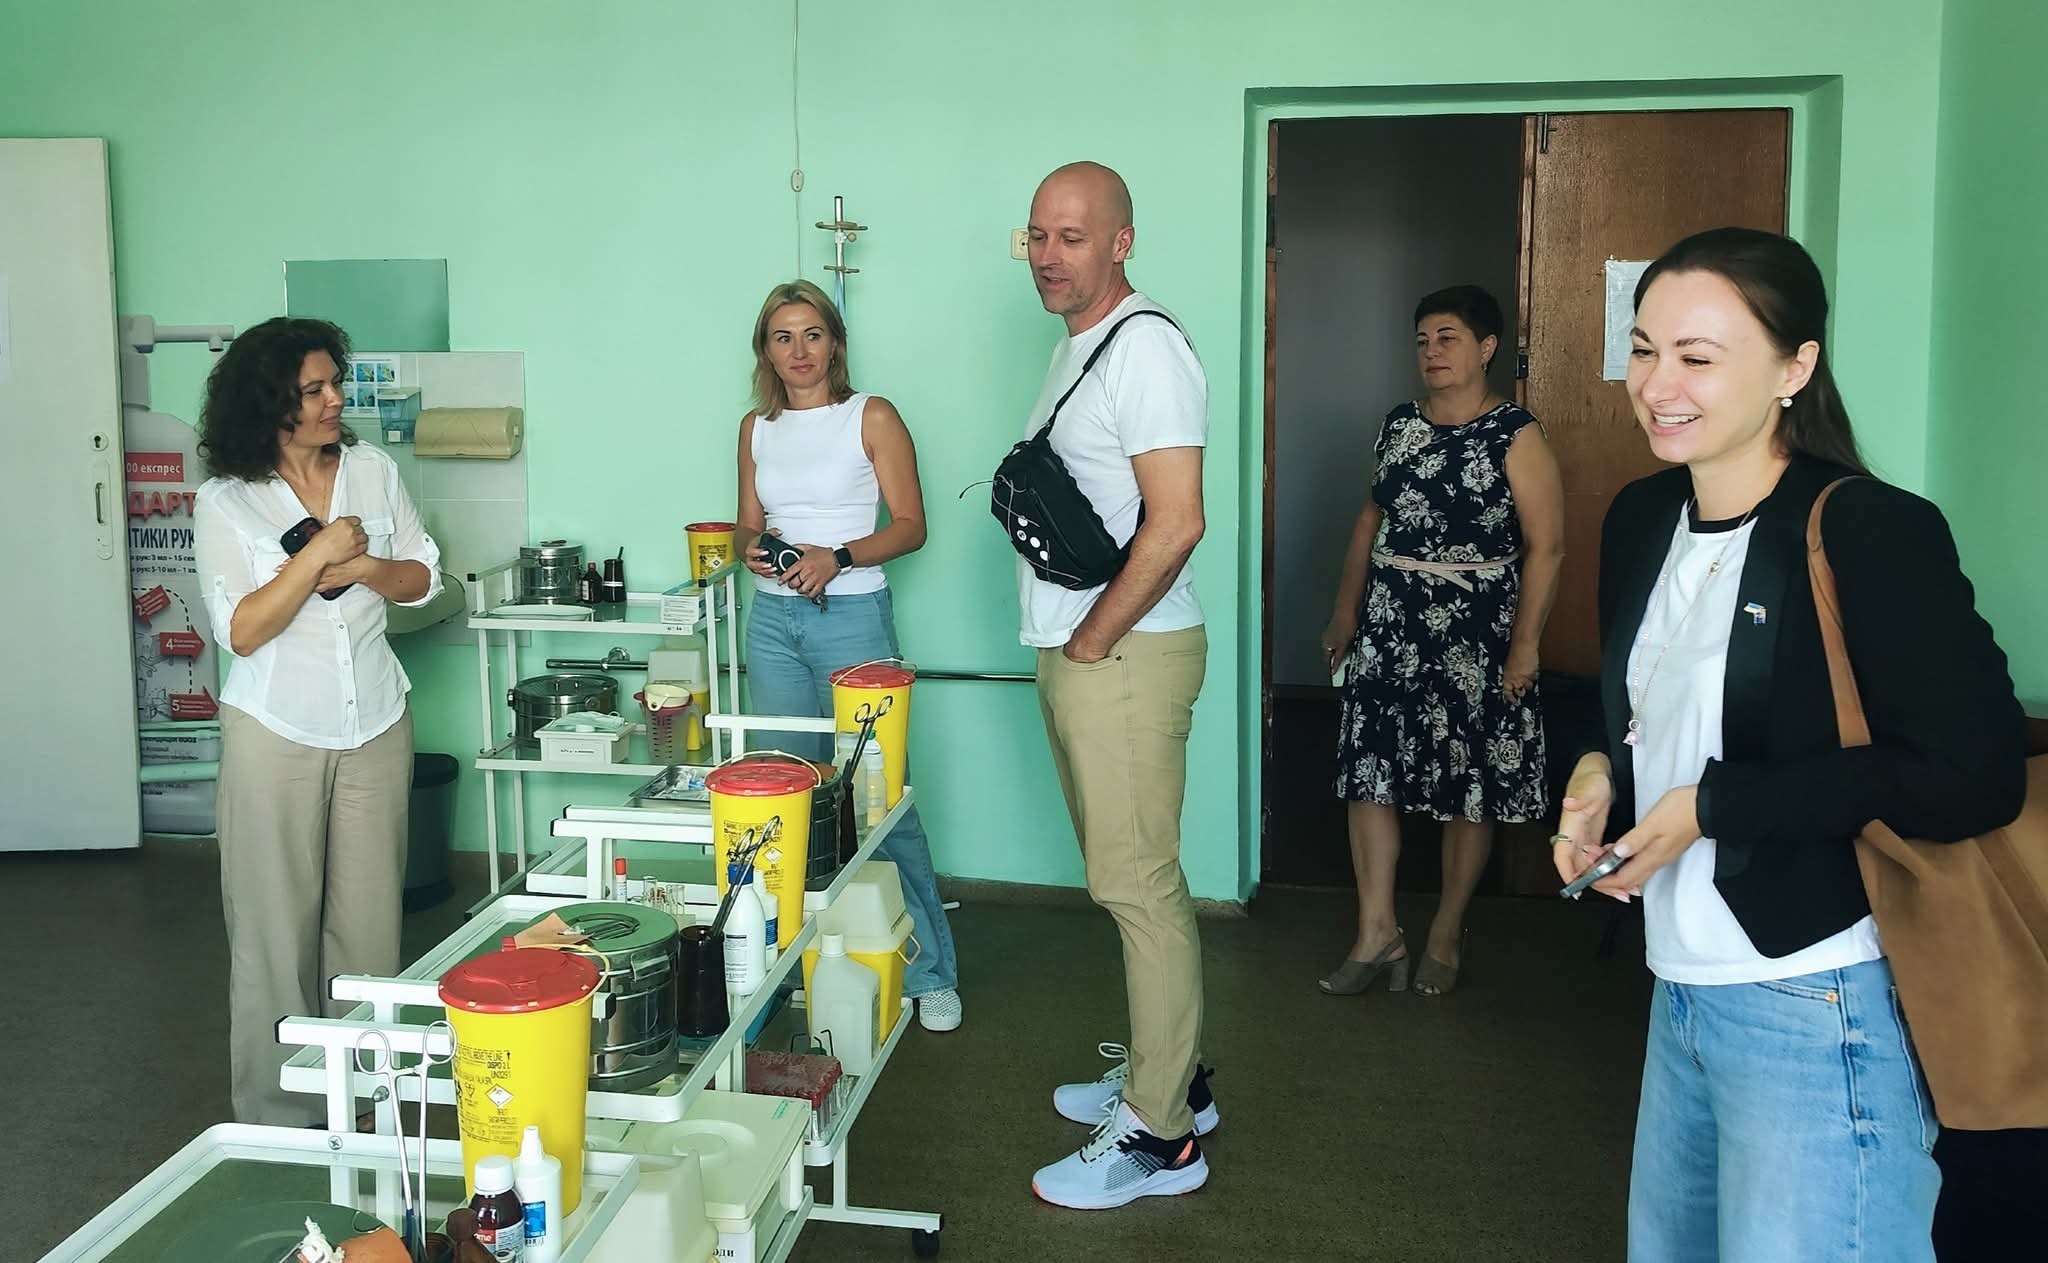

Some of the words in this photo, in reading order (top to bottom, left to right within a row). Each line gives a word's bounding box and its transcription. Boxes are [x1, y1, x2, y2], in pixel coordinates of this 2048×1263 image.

[141, 463, 181, 476] експрес
[166, 638, 174, 650] 4
[172, 699, 181, 712] 5
